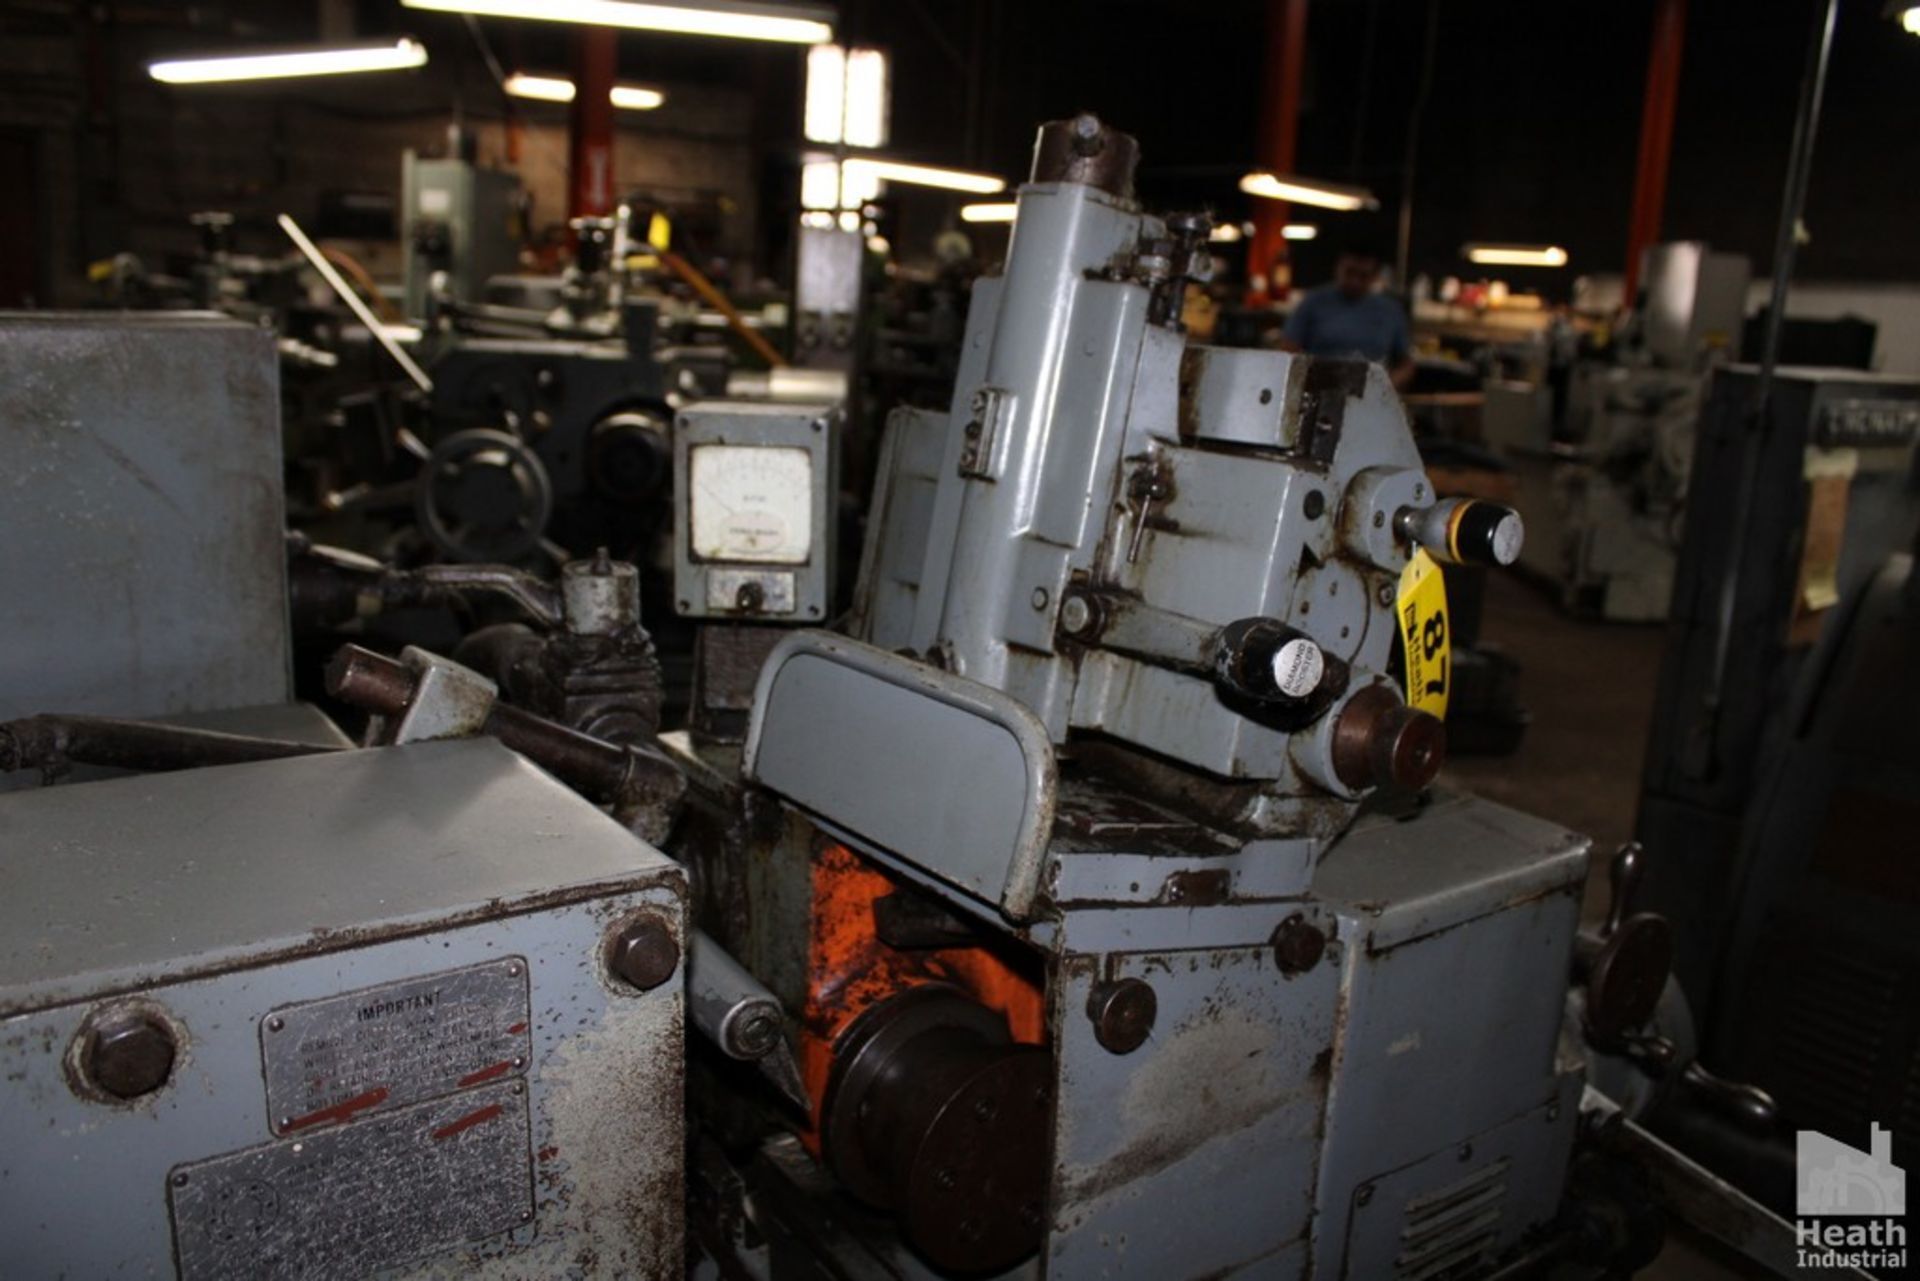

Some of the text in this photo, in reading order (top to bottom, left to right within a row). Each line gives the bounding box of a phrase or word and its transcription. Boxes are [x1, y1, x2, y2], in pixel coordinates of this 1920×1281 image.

[1284, 643, 1306, 689] DIAMOND
[1424, 610, 1446, 695] 87
[357, 990, 441, 1022] IMPORTANT
